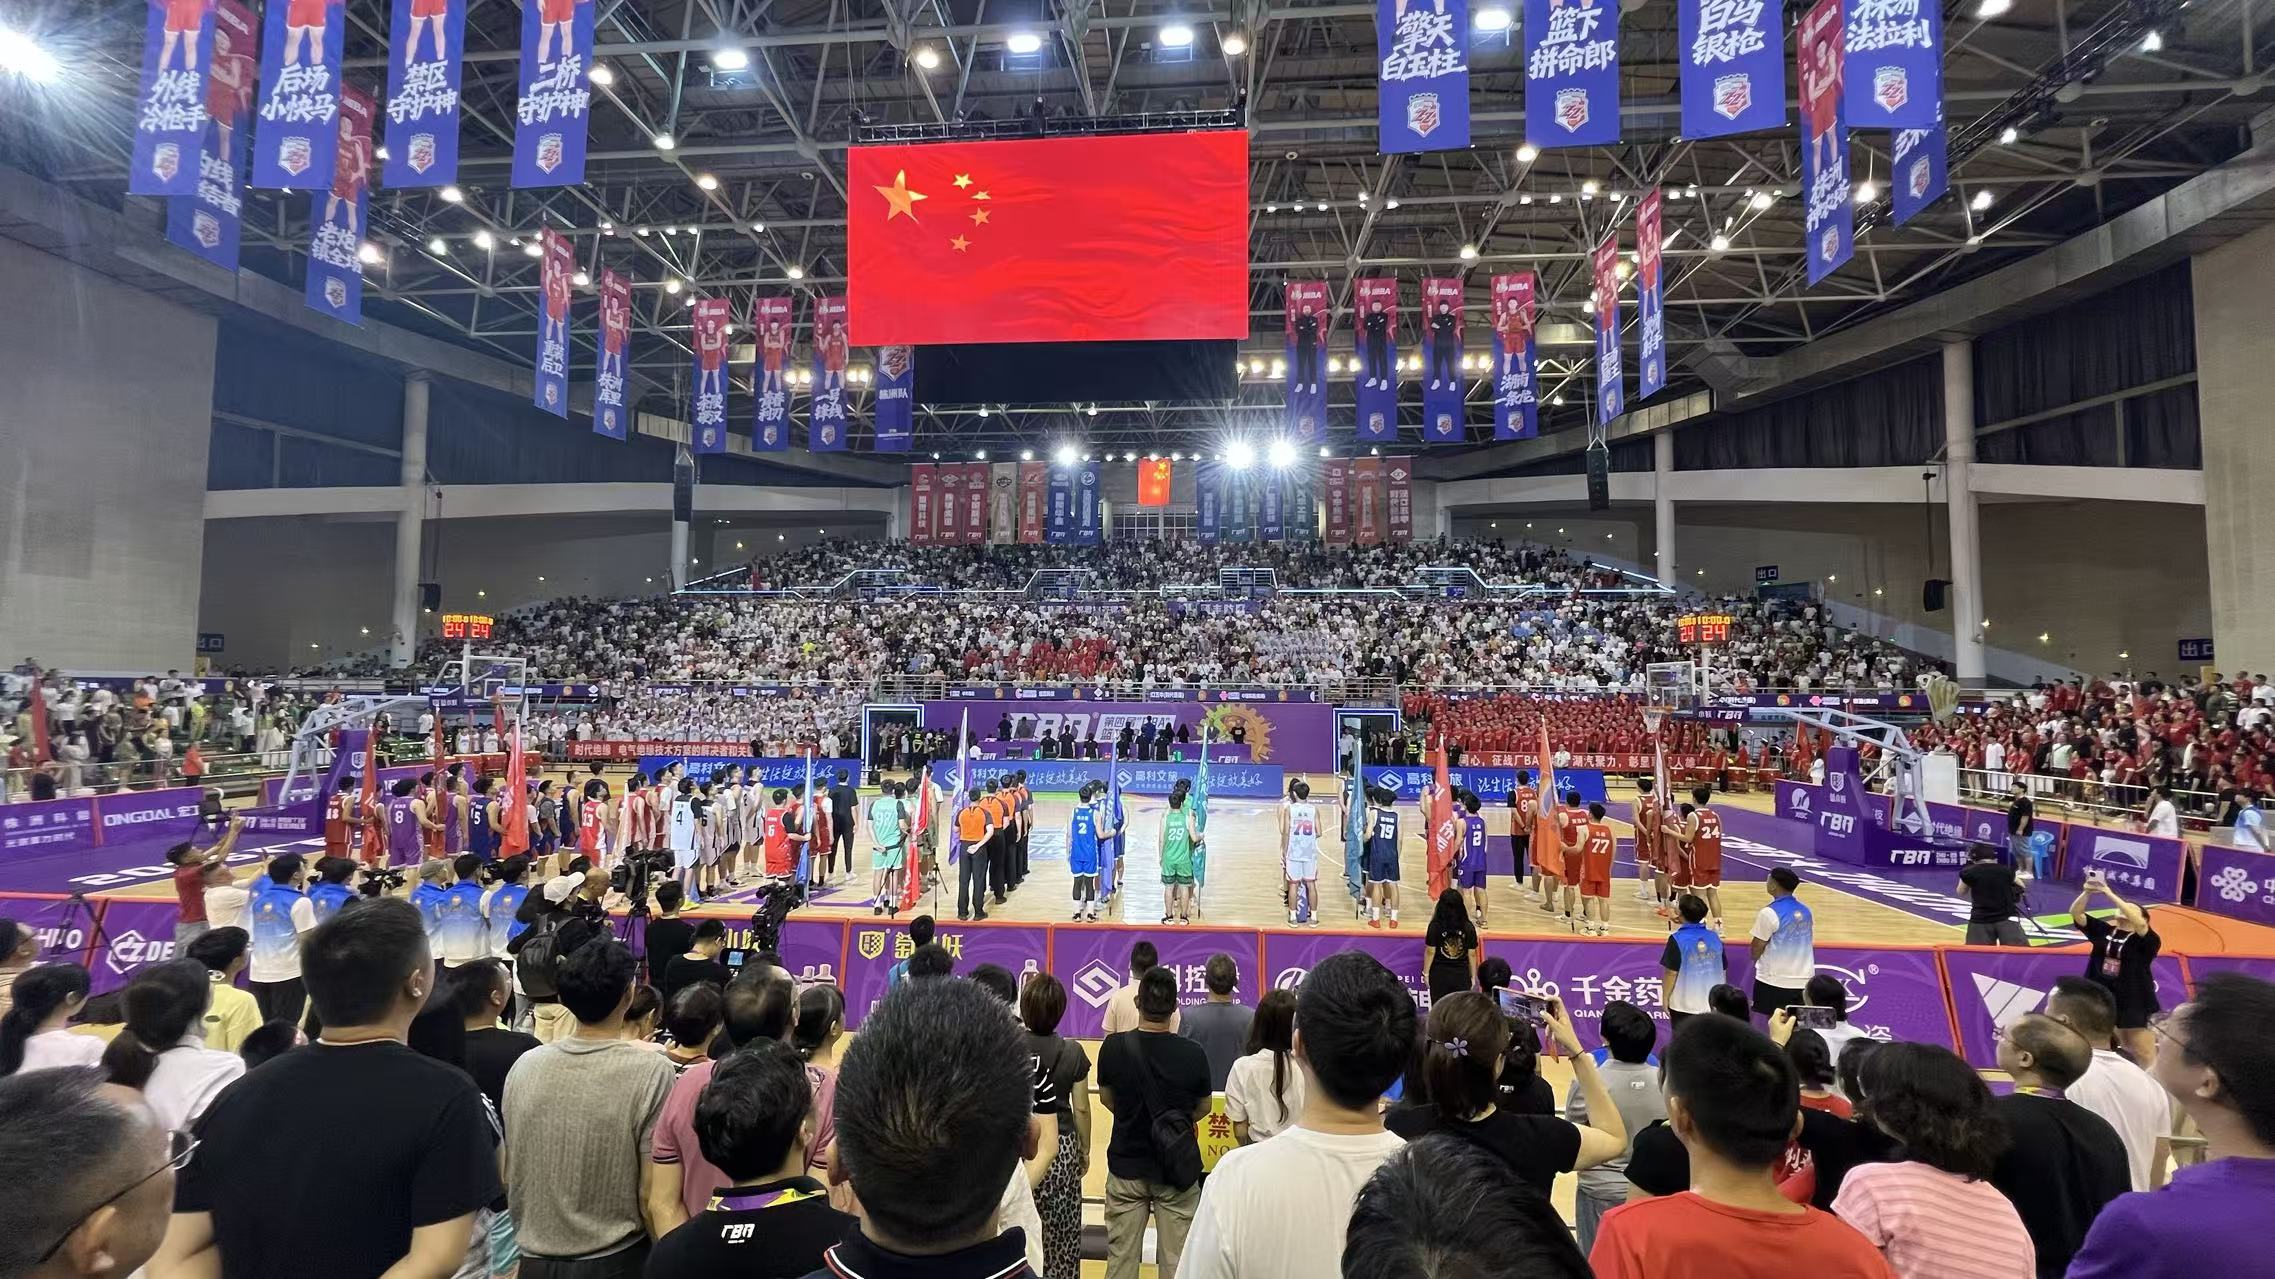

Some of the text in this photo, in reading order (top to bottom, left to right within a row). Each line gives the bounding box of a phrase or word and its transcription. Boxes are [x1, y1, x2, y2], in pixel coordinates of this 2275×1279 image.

[1393, 11, 1456, 54] 擎天
[1540, 7, 1602, 47] 篮下
[1845, 19, 1933, 53] 法拉利
[1528, 40, 1616, 80] 拼命郎
[1692, 29, 1766, 67] 银枪
[272, 62, 329, 95] 后场
[403, 60, 448, 96] 禁区
[530, 54, 581, 93] 二桥
[1381, 48, 1467, 82] 白玉柱
[149, 70, 200, 103] 外线
[140, 103, 206, 132] 冷枪手
[260, 94, 337, 125] 小快马
[387, 89, 458, 124] 守护神
[518, 88, 590, 126] 守护神
[445, 623, 489, 638] 24 24
[1680, 625, 1726, 642] 24 24
[575, 744, 611, 757] 时代绝缘
[1407, 772, 1463, 785] 高科旅
[104, 808, 174, 827] ONGOAL
[394, 811, 404, 824] 8
[676, 811, 683, 826] 4
[1077, 822, 1087, 834] 2
[1379, 823, 1394, 840] 19
[1168, 827, 1185, 841] 29
[1472, 831, 1481, 846] 2
[1590, 838, 1608, 854] 77
[1700, 826, 1719, 840] 24
[1571, 975, 1664, 1005] 千金药
[1208, 1112, 1231, 1139] 禁
